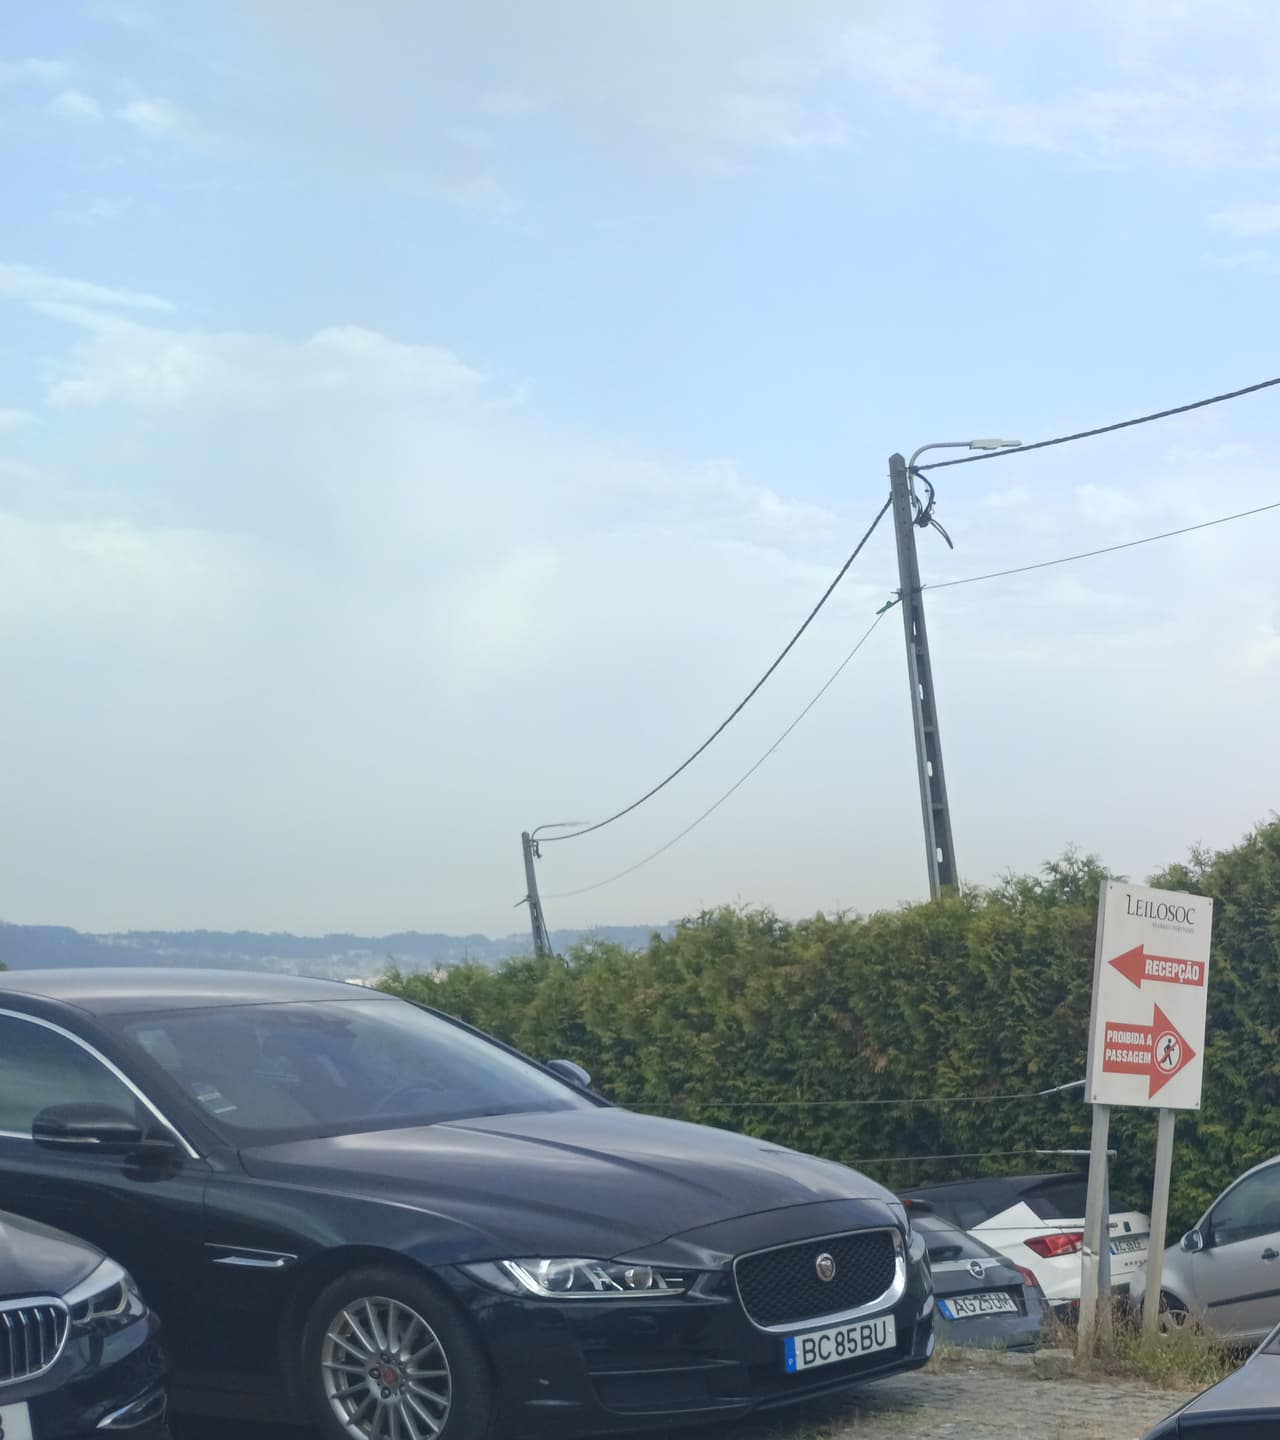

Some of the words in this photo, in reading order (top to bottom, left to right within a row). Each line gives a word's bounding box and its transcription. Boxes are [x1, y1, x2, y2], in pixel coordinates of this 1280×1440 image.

[1126, 893, 1196, 925] LEILOSOC
[1145, 960, 1200, 983] RECEPÇÃO
[1106, 1030, 1145, 1046] PROIBIDA
[1146, 1033, 1152, 1047] A
[1105, 1049, 1152, 1065] PASSAGEM
